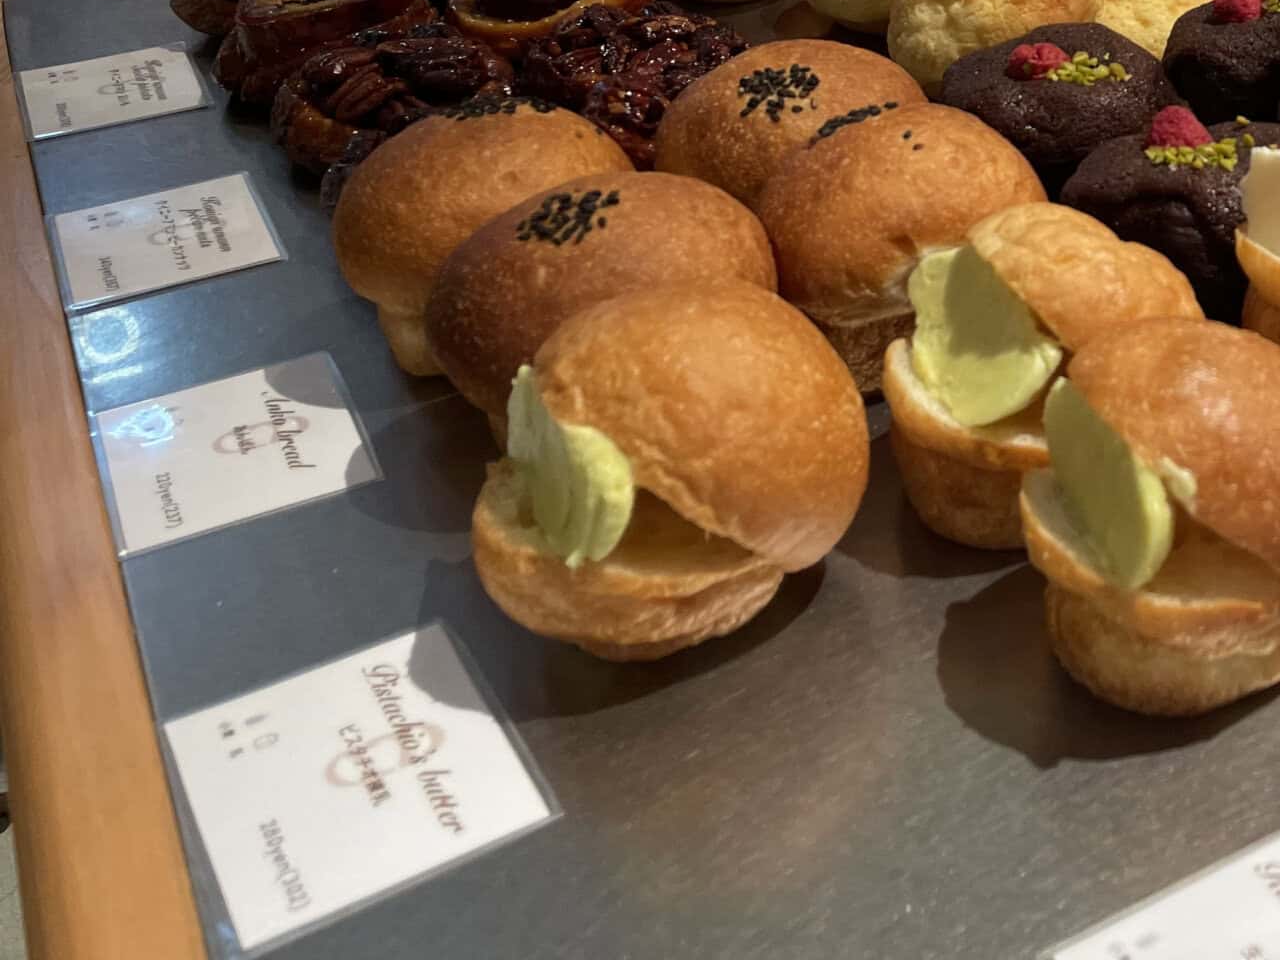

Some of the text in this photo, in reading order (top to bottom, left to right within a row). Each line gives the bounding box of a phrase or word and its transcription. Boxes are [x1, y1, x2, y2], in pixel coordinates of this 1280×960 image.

[261, 391, 316, 470] Anko bread
[155, 472, 183, 529] 220yen(237)
[362, 663, 465, 835] Pistachio's butter
